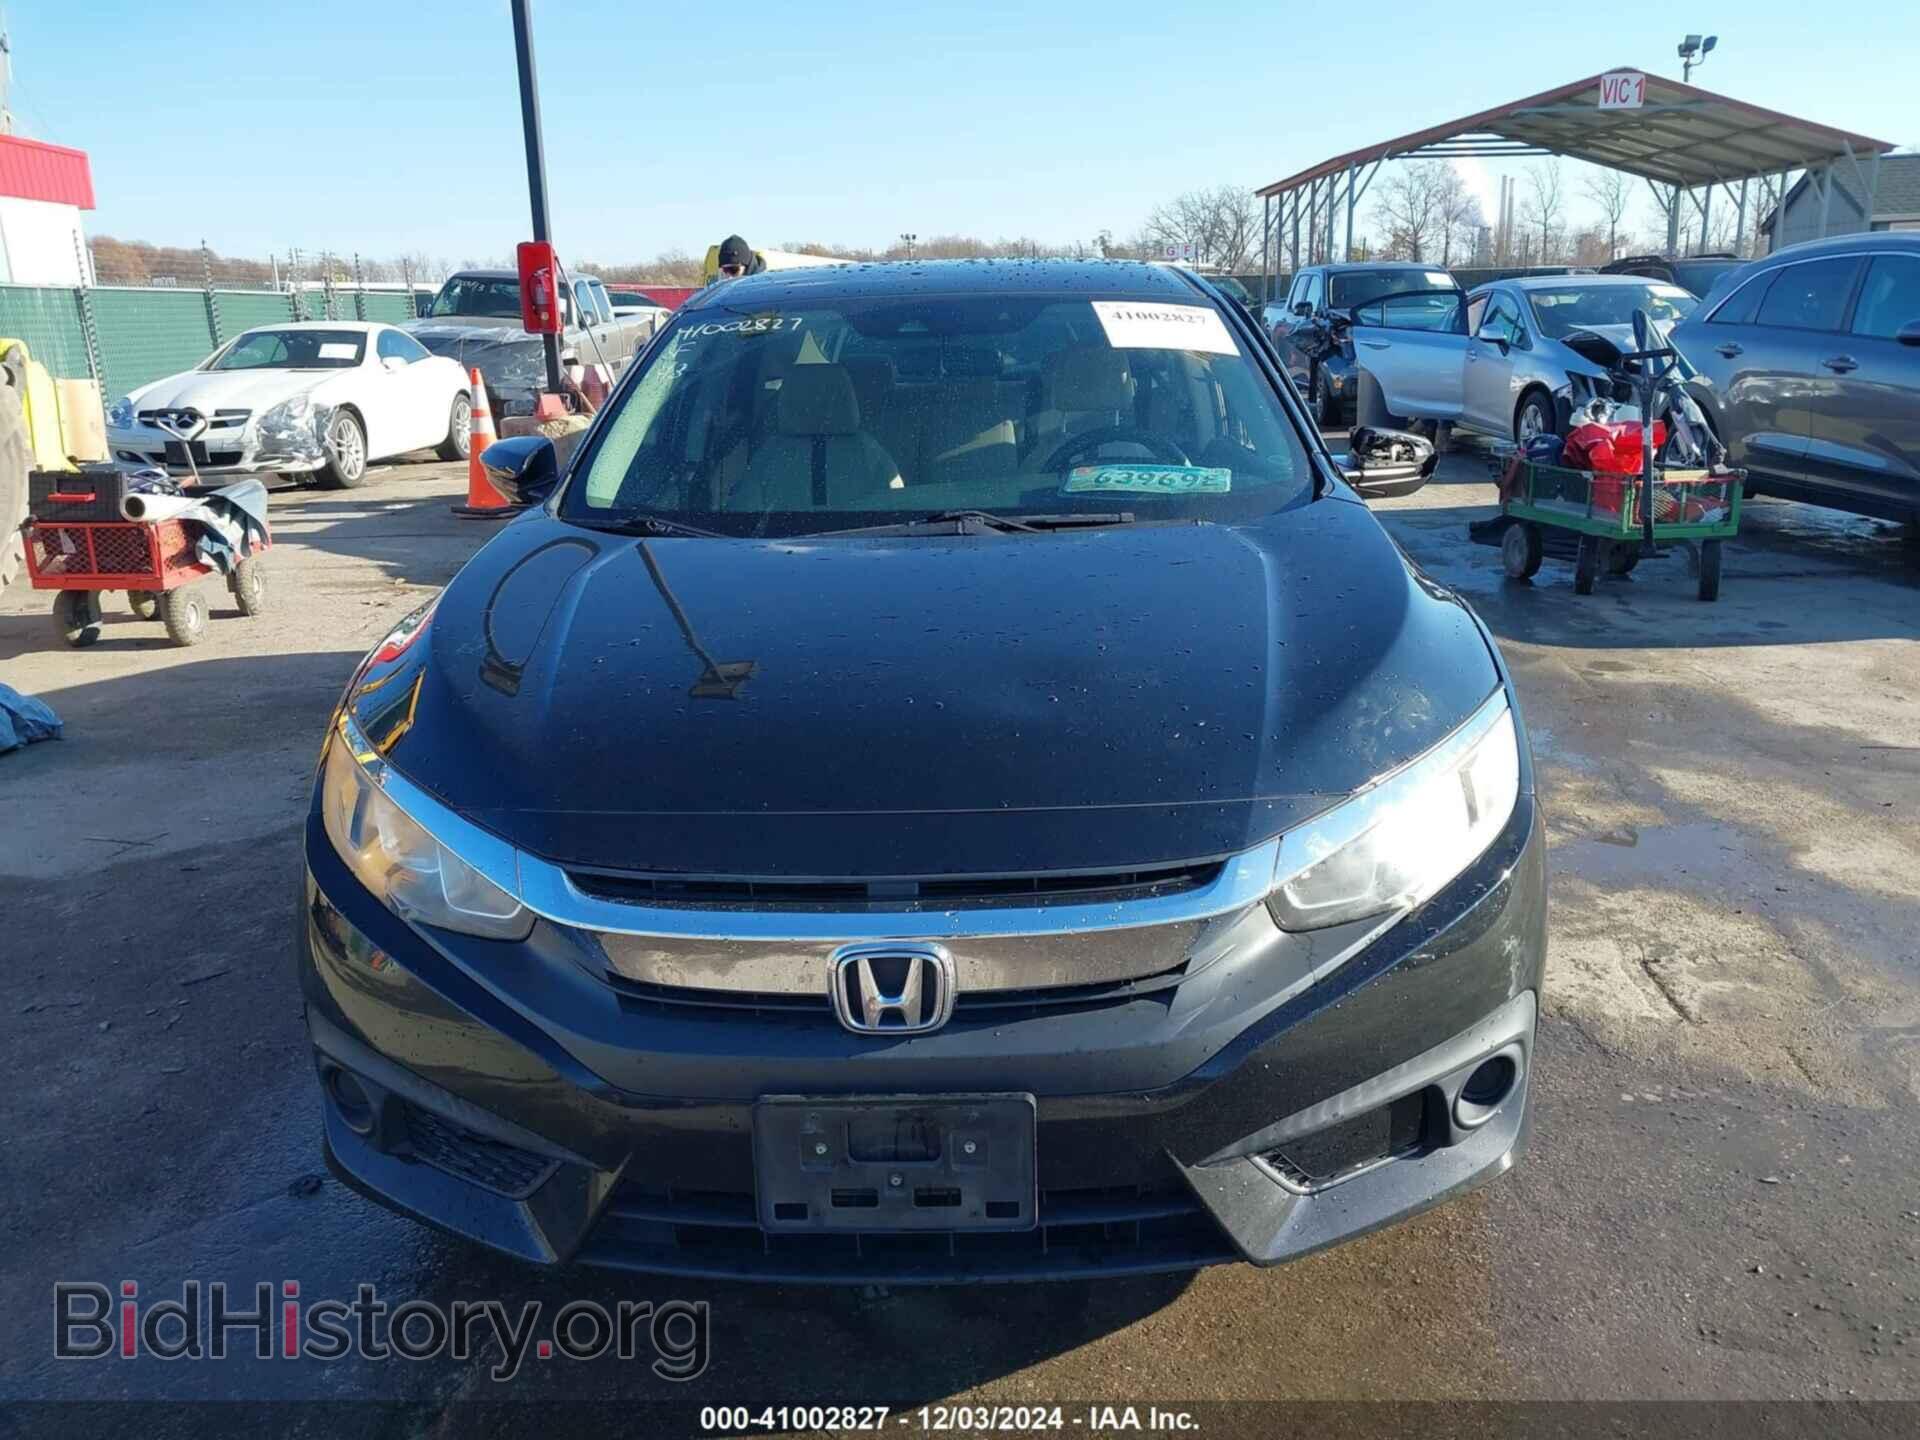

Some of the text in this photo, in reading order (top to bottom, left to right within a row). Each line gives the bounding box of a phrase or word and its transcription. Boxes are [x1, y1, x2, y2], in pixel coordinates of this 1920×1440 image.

[1602, 78, 1644, 104] VIC 1
[679, 317, 803, 340] 41002827
[1111, 310, 1207, 325] 41002827
